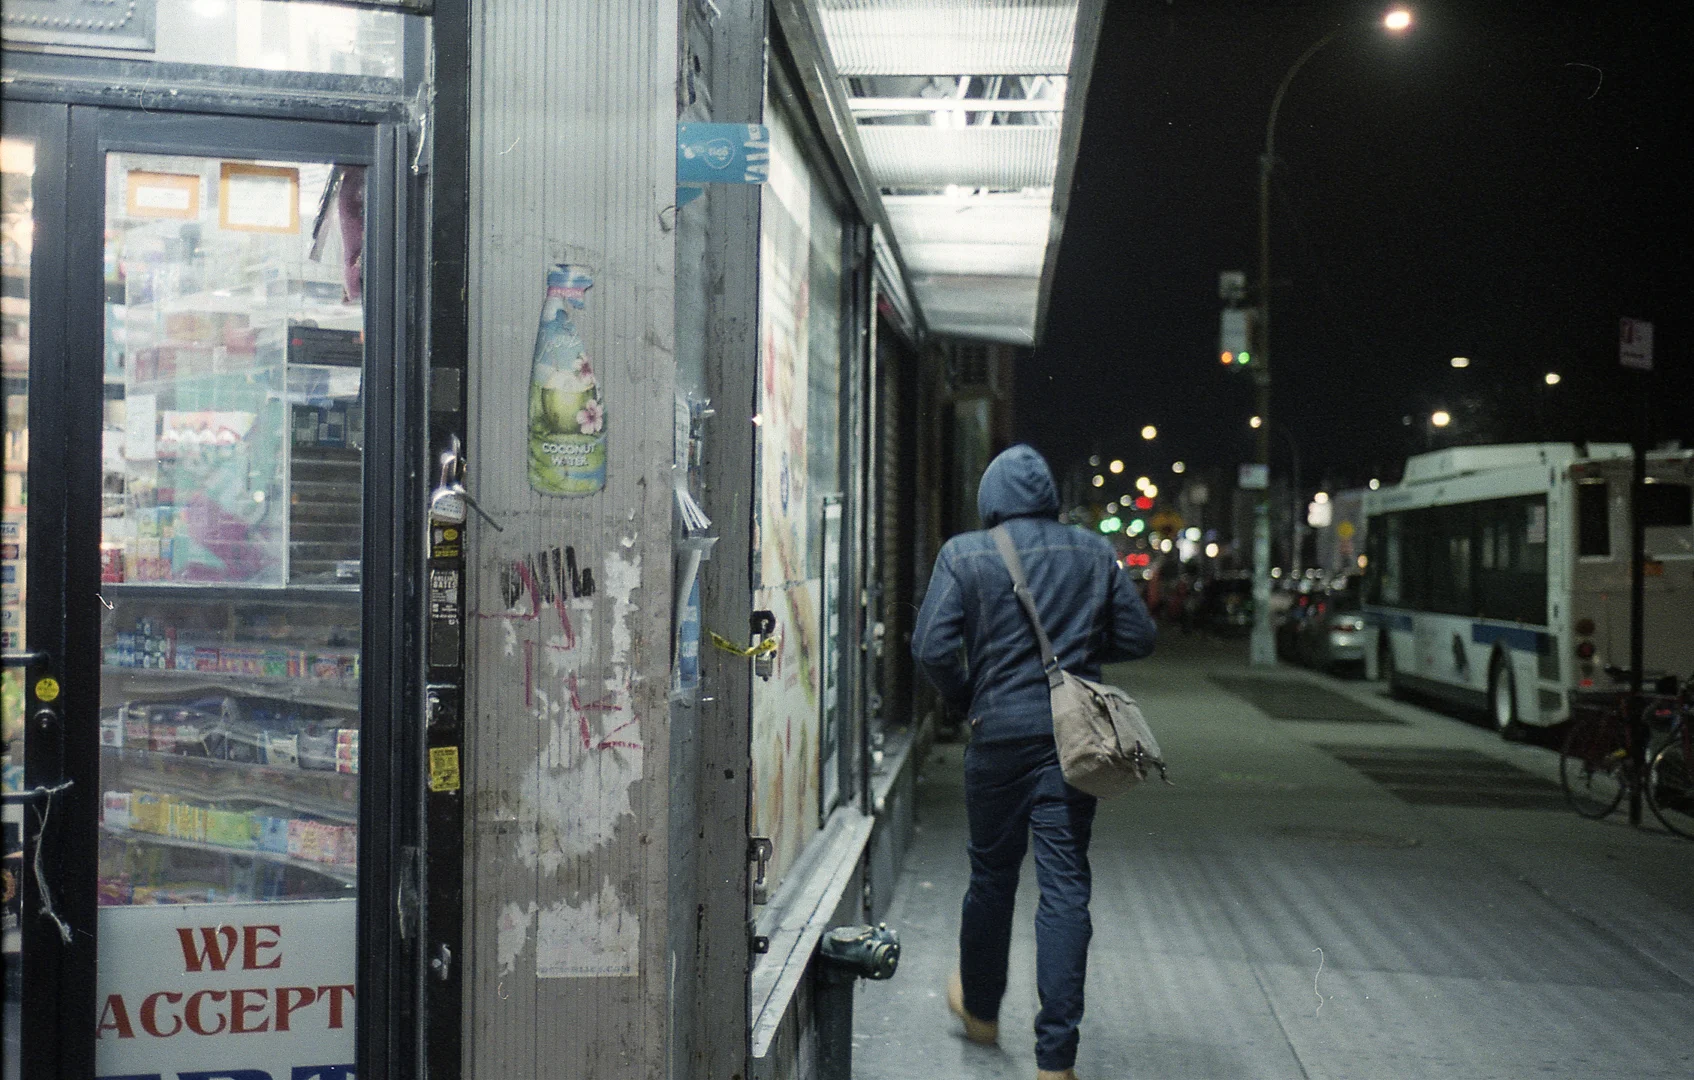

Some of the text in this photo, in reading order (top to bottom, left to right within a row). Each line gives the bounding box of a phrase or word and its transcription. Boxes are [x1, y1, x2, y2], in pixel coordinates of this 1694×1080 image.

[542, 443, 596, 455] COCONUT
[551, 455, 589, 466] WATER
[176, 925, 282, 972] WE
[95, 985, 355, 1039] ACCEPT
